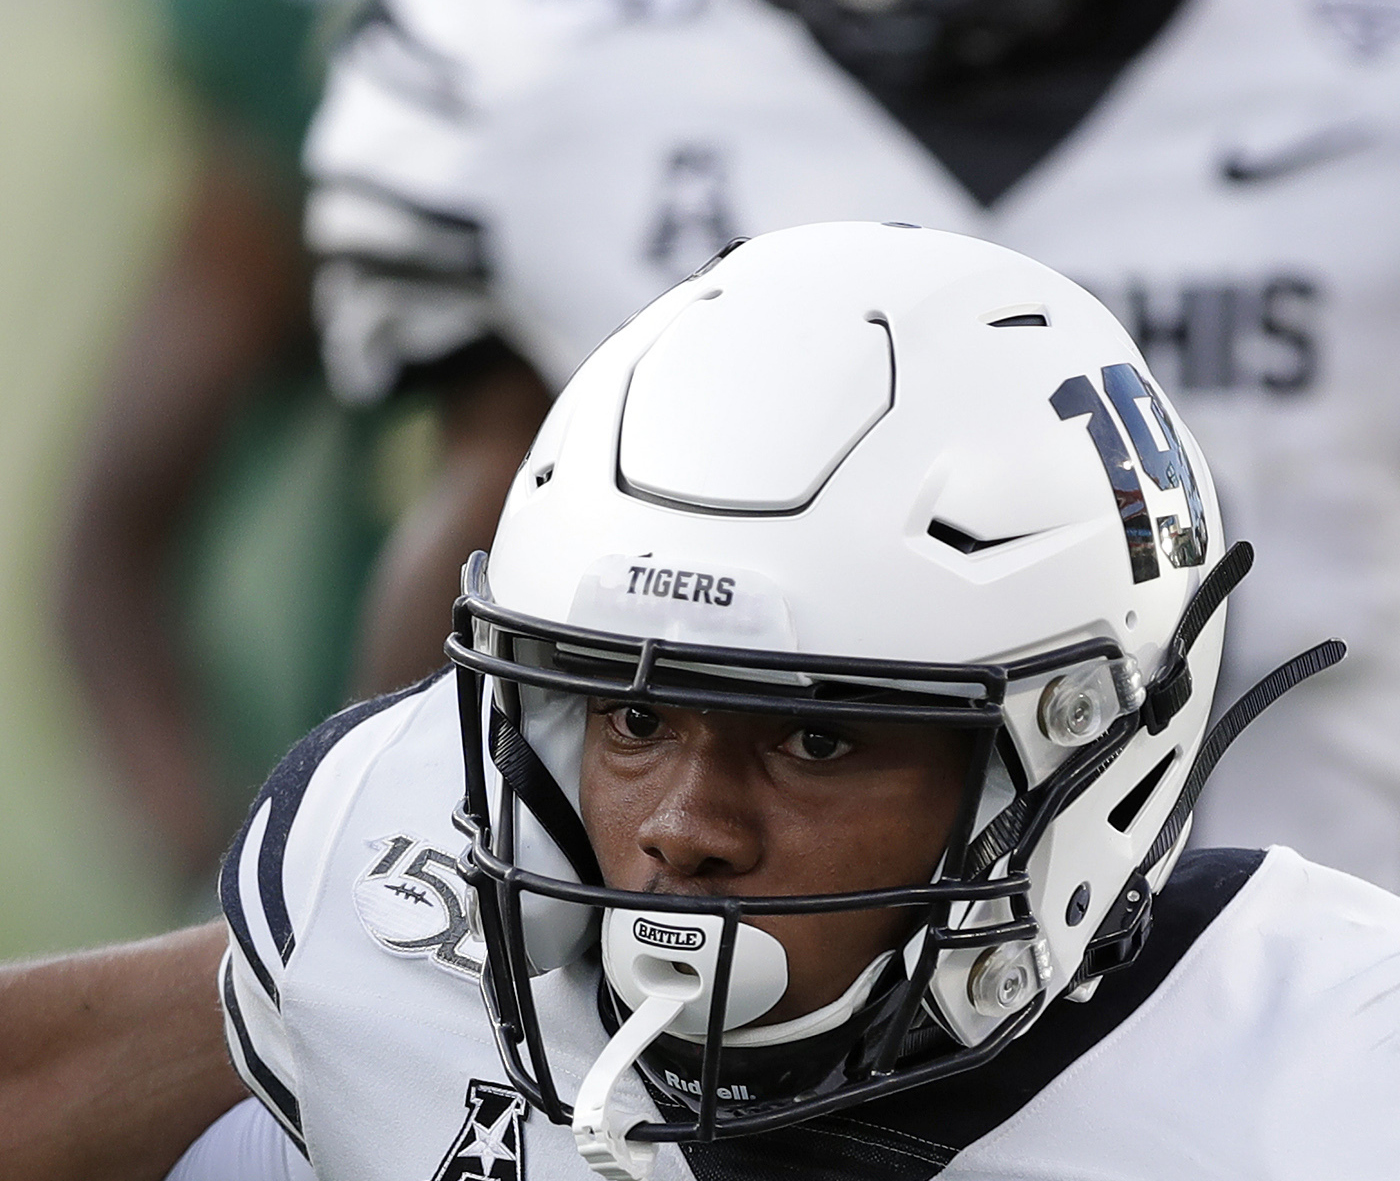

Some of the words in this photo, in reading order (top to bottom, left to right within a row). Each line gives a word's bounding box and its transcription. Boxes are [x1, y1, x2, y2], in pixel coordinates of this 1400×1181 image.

[1048, 362, 1210, 585] 19
[626, 565, 736, 608] TIGERS
[637, 922, 699, 948] BATTLE
[664, 1069, 748, 1102] Ridell
